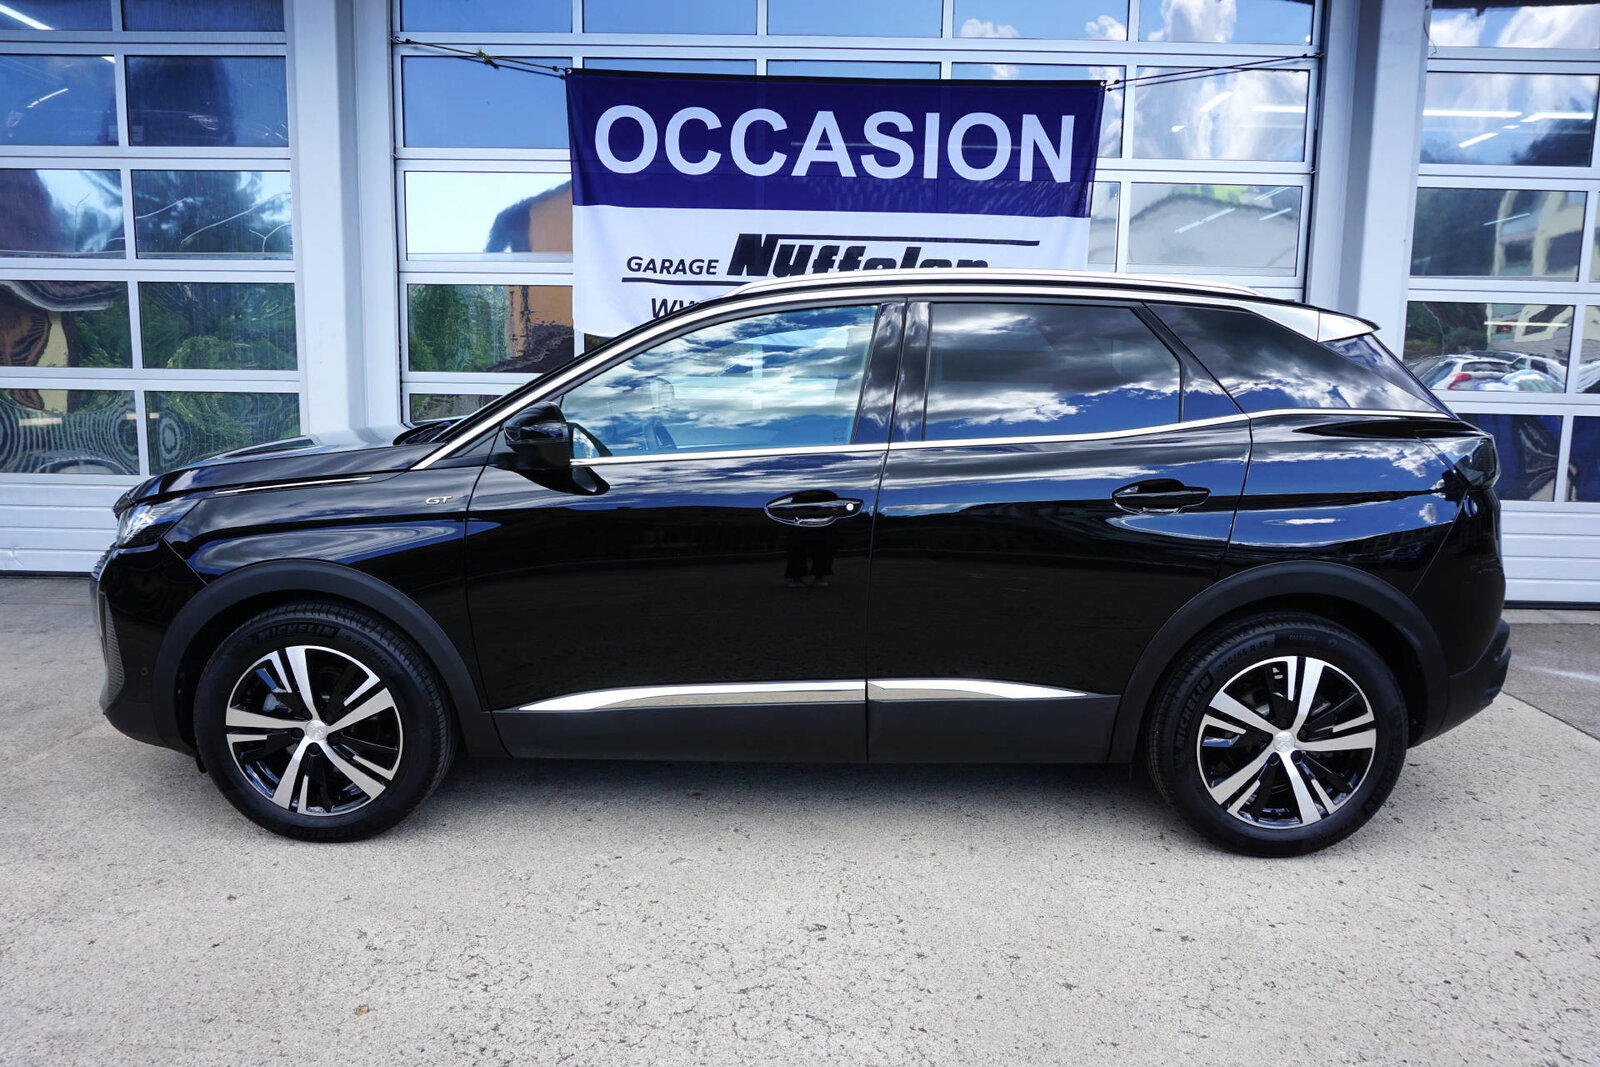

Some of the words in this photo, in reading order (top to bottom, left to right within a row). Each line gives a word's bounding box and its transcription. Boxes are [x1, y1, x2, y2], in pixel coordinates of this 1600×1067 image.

[595, 105, 1075, 183] OCCASION
[626, 256, 719, 276] GARAGE
[425, 495, 453, 505] GT
[257, 624, 335, 639] MICHELIN
[1175, 674, 1212, 749] MICHELIN
